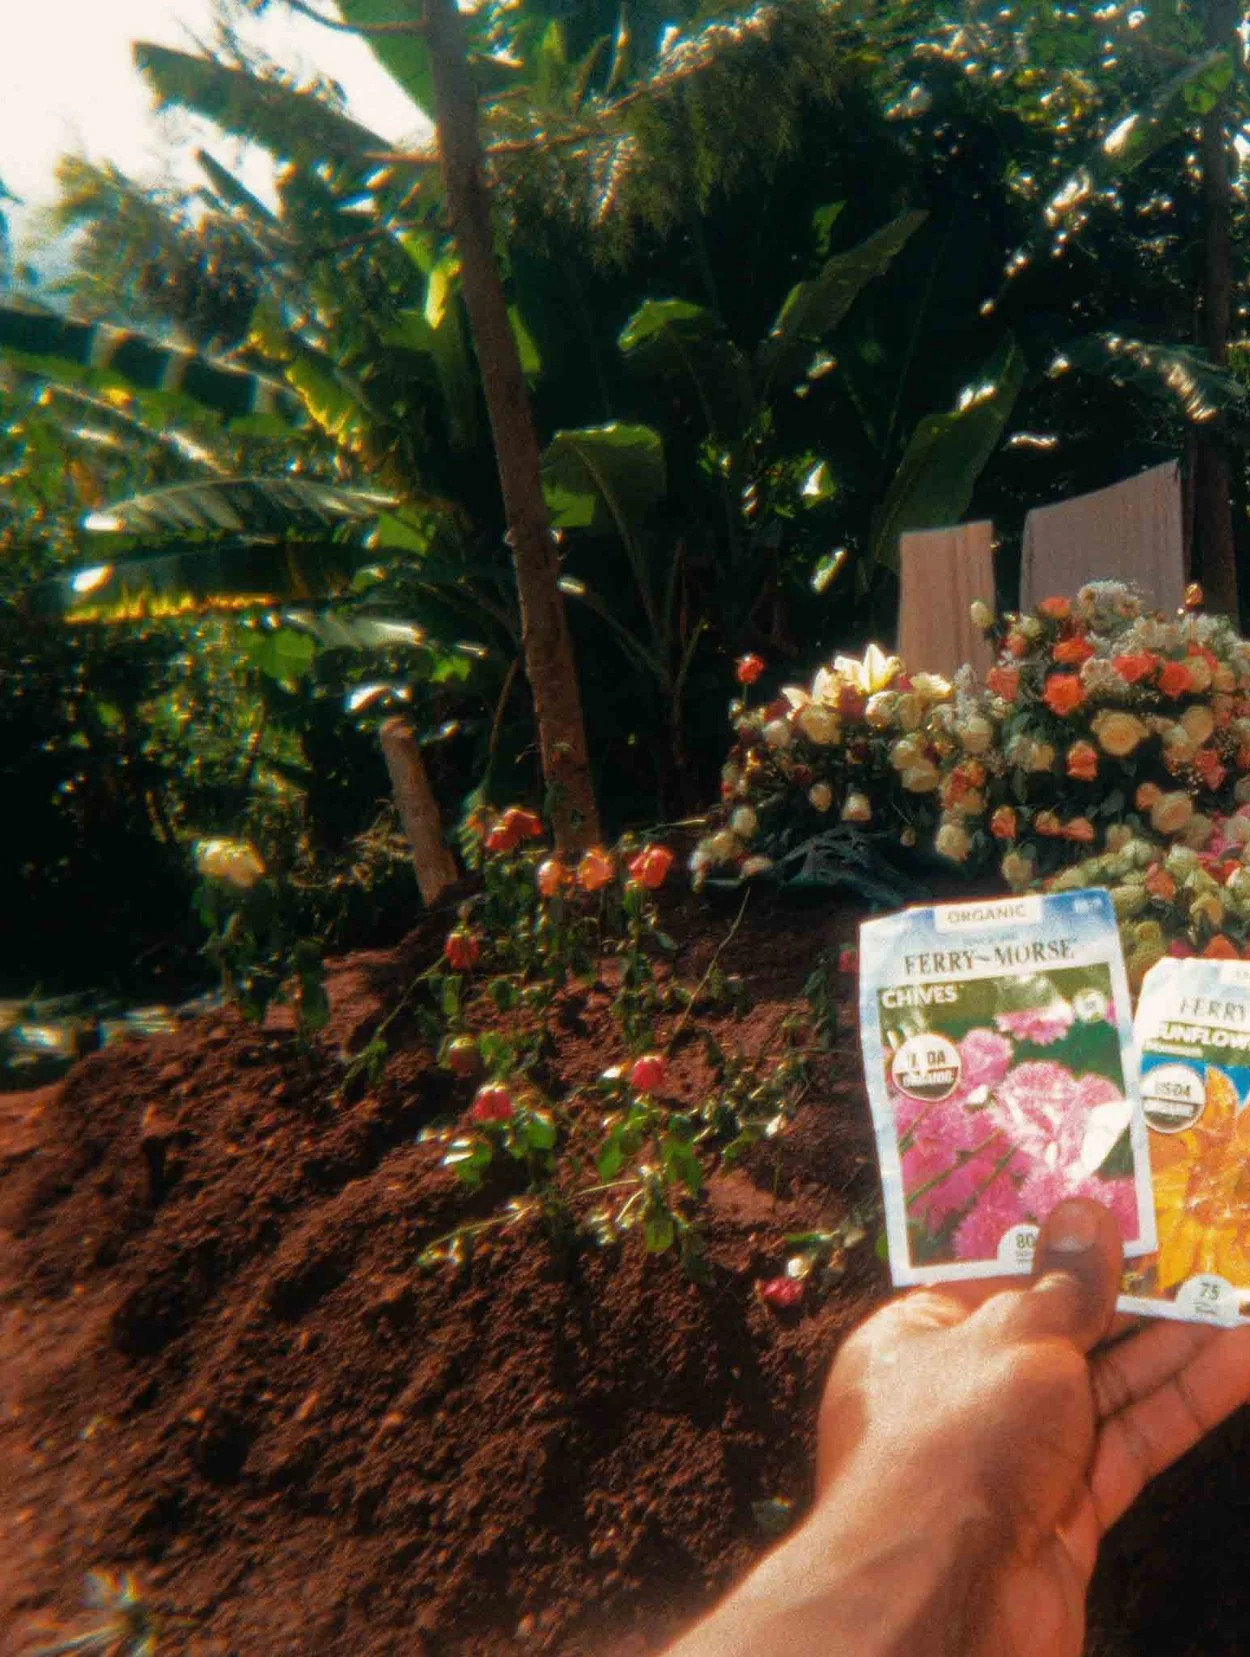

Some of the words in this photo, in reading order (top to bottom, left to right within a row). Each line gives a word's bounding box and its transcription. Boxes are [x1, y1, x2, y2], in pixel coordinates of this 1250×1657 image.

[946, 903, 1027, 923] ORGANIC
[881, 984, 958, 1008] CHIVES
[906, 1050, 946, 1069] UDA
[1199, 1281, 1220, 1301] 75
